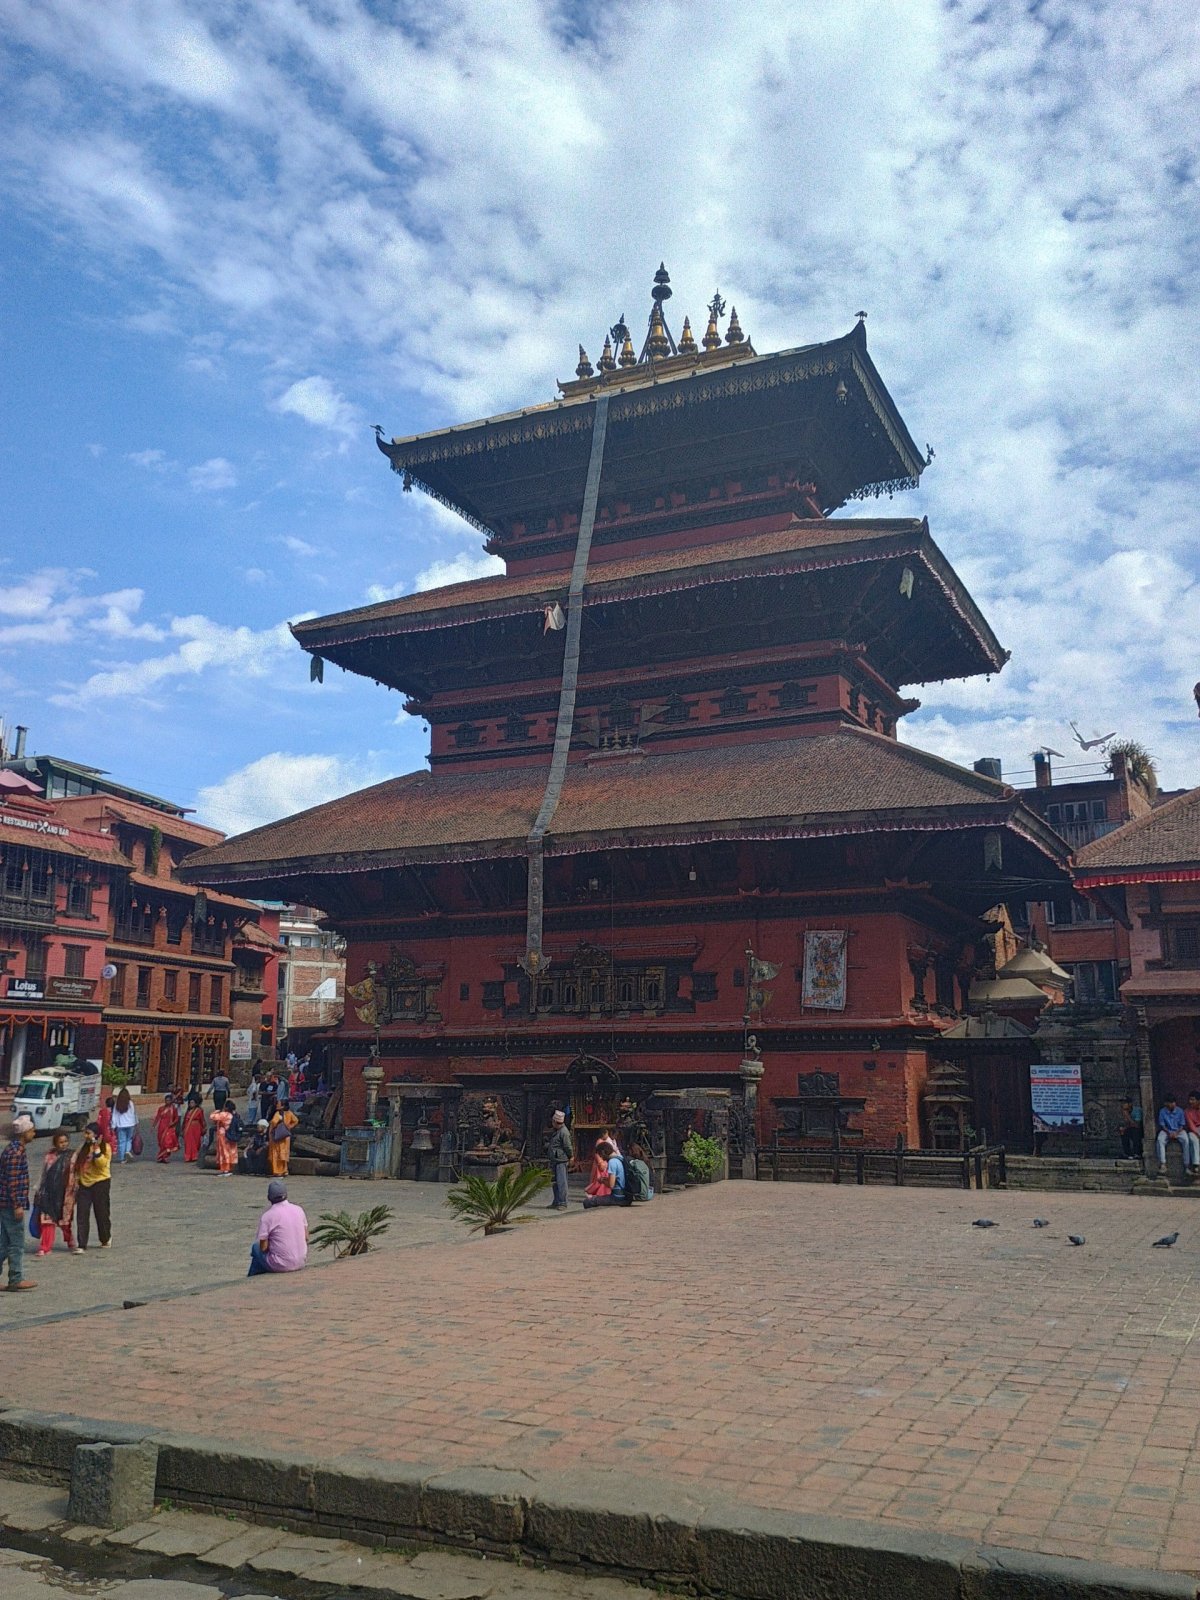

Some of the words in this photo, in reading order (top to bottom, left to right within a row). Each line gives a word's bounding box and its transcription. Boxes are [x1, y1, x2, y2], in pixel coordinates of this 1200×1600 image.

[3, 815, 38, 830] RESTAURANT
[46, 825, 58, 835] AND
[58, 827, 70, 836] BAR
[14, 979, 37, 991] Lotus
